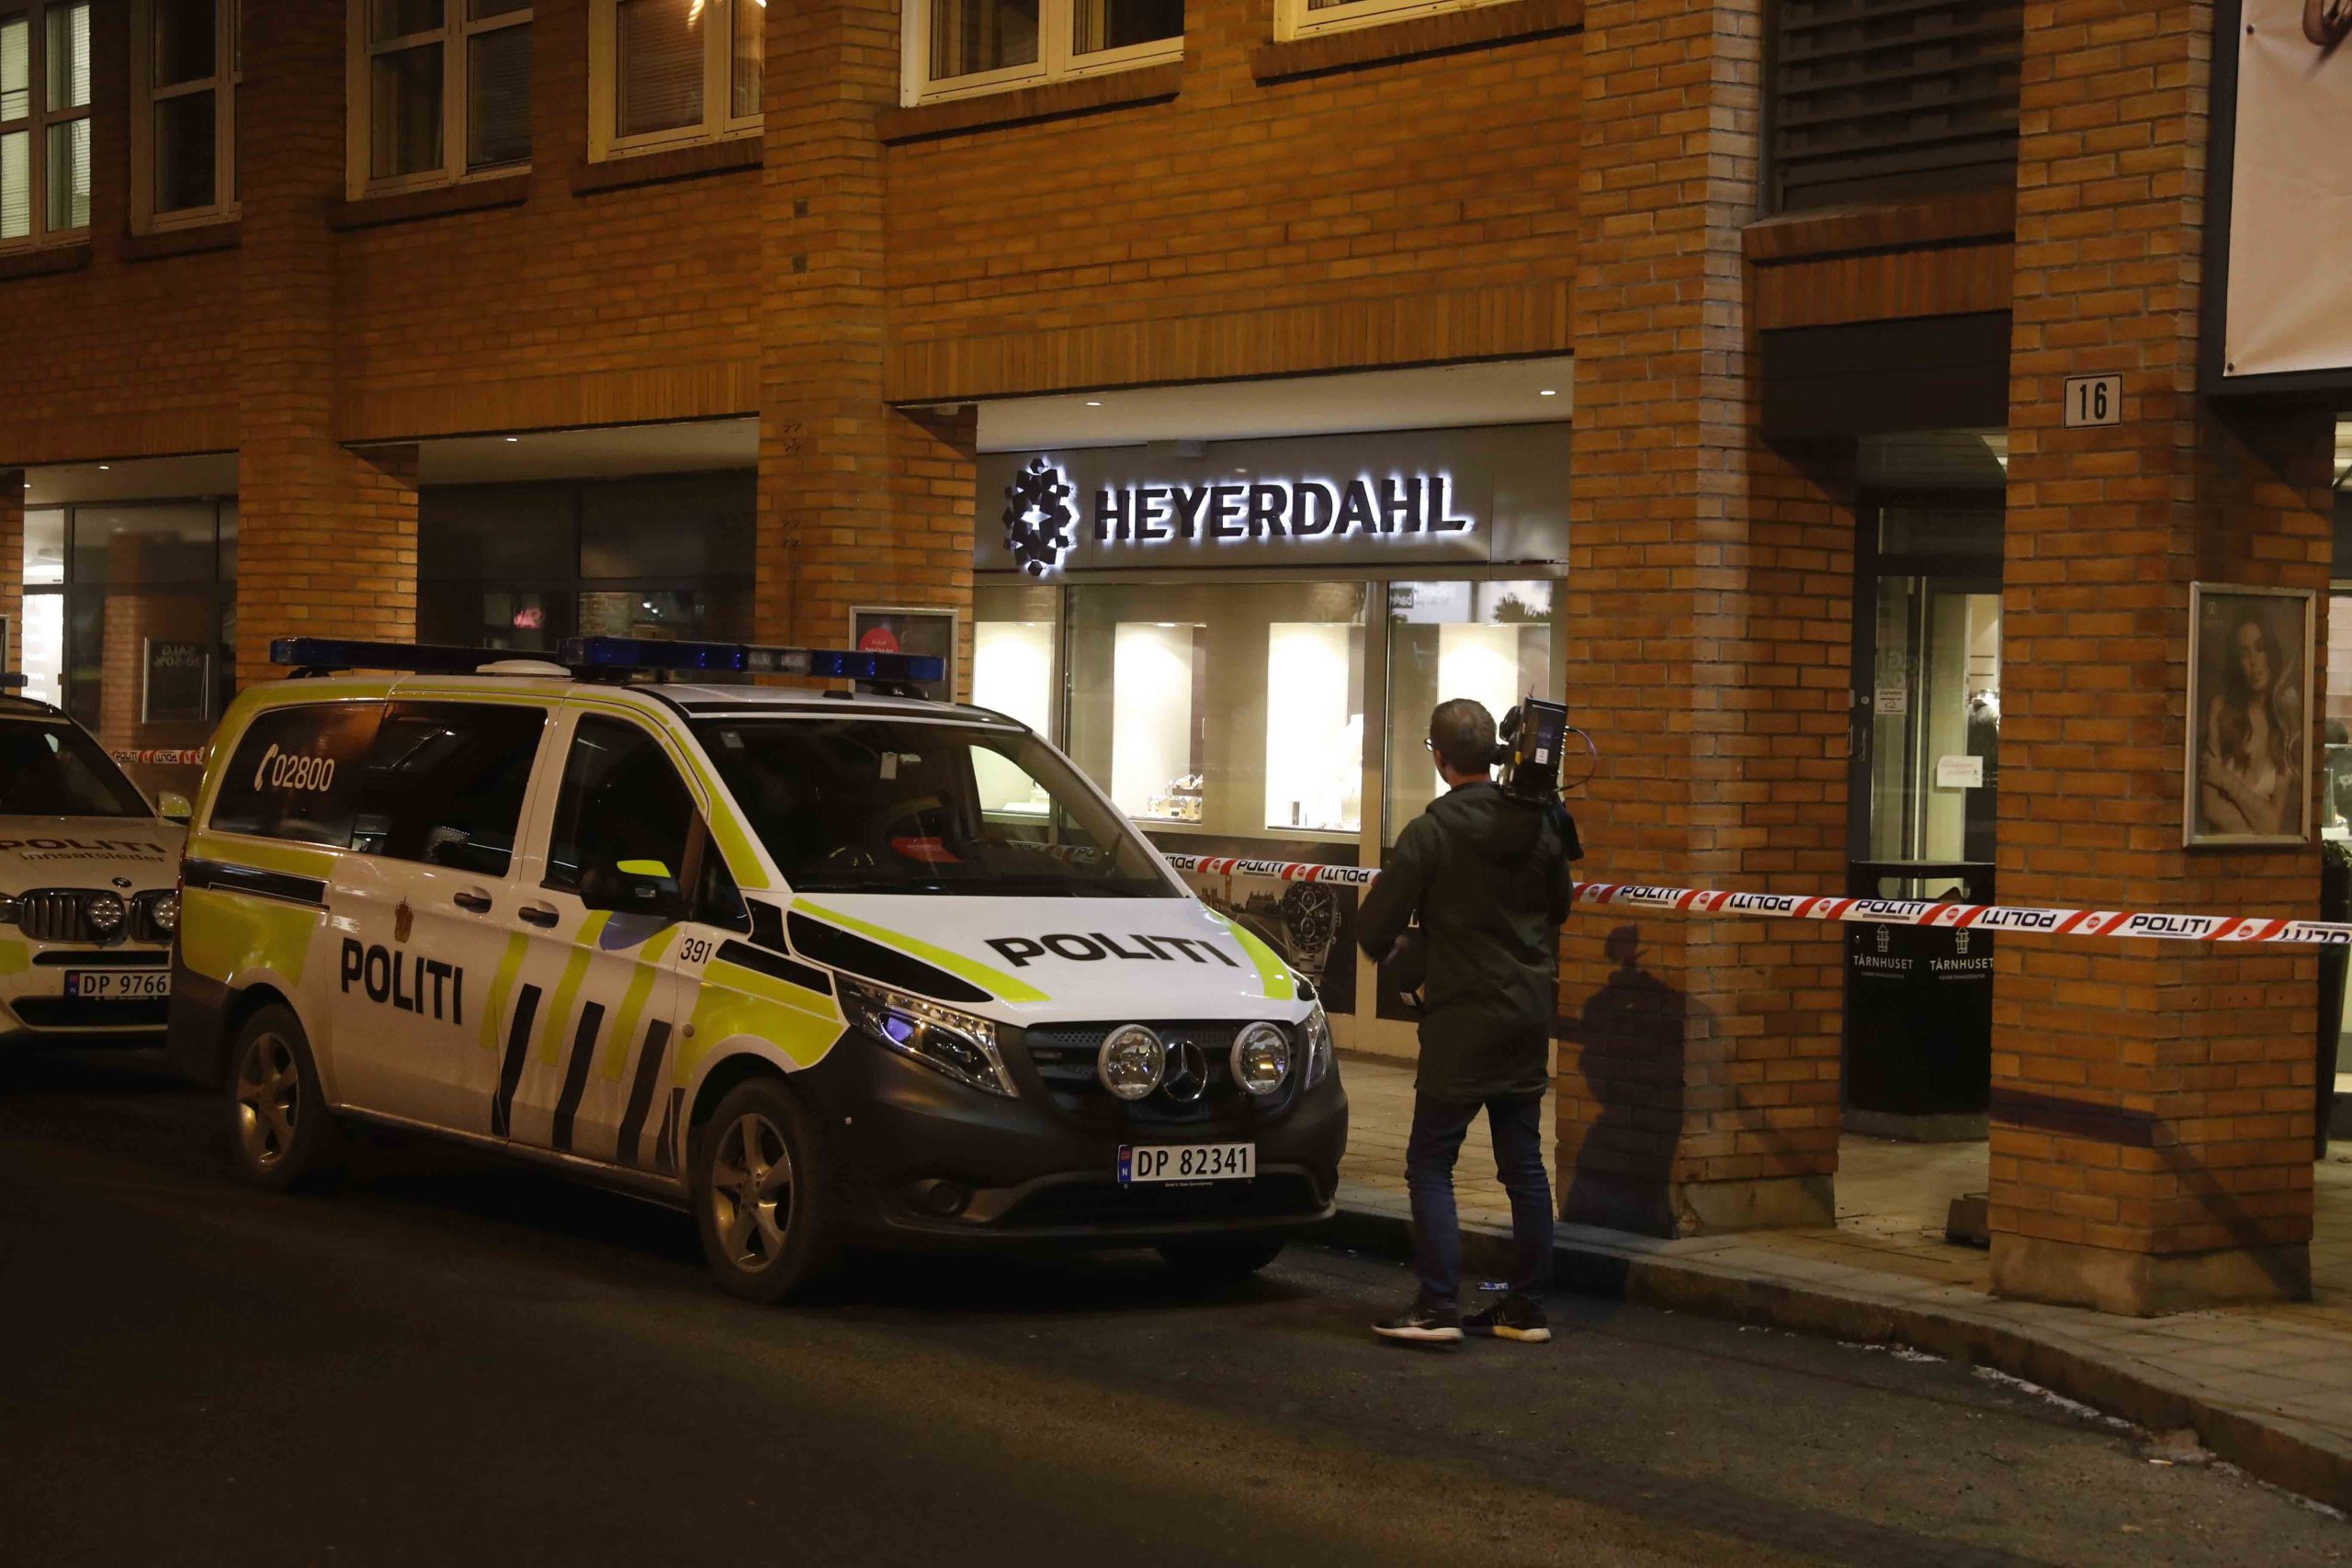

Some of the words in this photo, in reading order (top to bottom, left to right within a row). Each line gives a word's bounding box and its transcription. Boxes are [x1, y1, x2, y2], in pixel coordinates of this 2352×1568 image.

[2079, 381, 2107, 421] 16
[1093, 477, 1467, 540] HEYERDAHL
[272, 753, 335, 793] 02800
[0, 839, 167, 853] POLITI
[20, 852, 165, 863] innsatsleder
[1165, 855, 1196, 870] POL
[1237, 860, 1284, 873] POLITI
[1321, 867, 1370, 884] POLITI
[1620, 886, 1681, 900] POLITI
[1729, 894, 1794, 911] POLITI
[1854, 900, 1926, 915] POLITI
[1981, 910, 2058, 928] POLITI
[2130, 916, 2212, 933] POLITI
[2279, 928, 2352, 943] OLITI
[681, 938, 713, 964] 391
[984, 932, 1240, 967] POLITI
[1852, 953, 1914, 970] TÅRNHUSET
[1930, 957, 1995, 971] TÅRNHUSET
[84, 976, 110, 994] DP
[120, 976, 169, 994] 9766
[341, 937, 463, 1025] POLITI
[1137, 1150, 1169, 1177] DP
[1180, 1147, 1247, 1175] 82341
[1122, 1168, 1128, 1176] N
